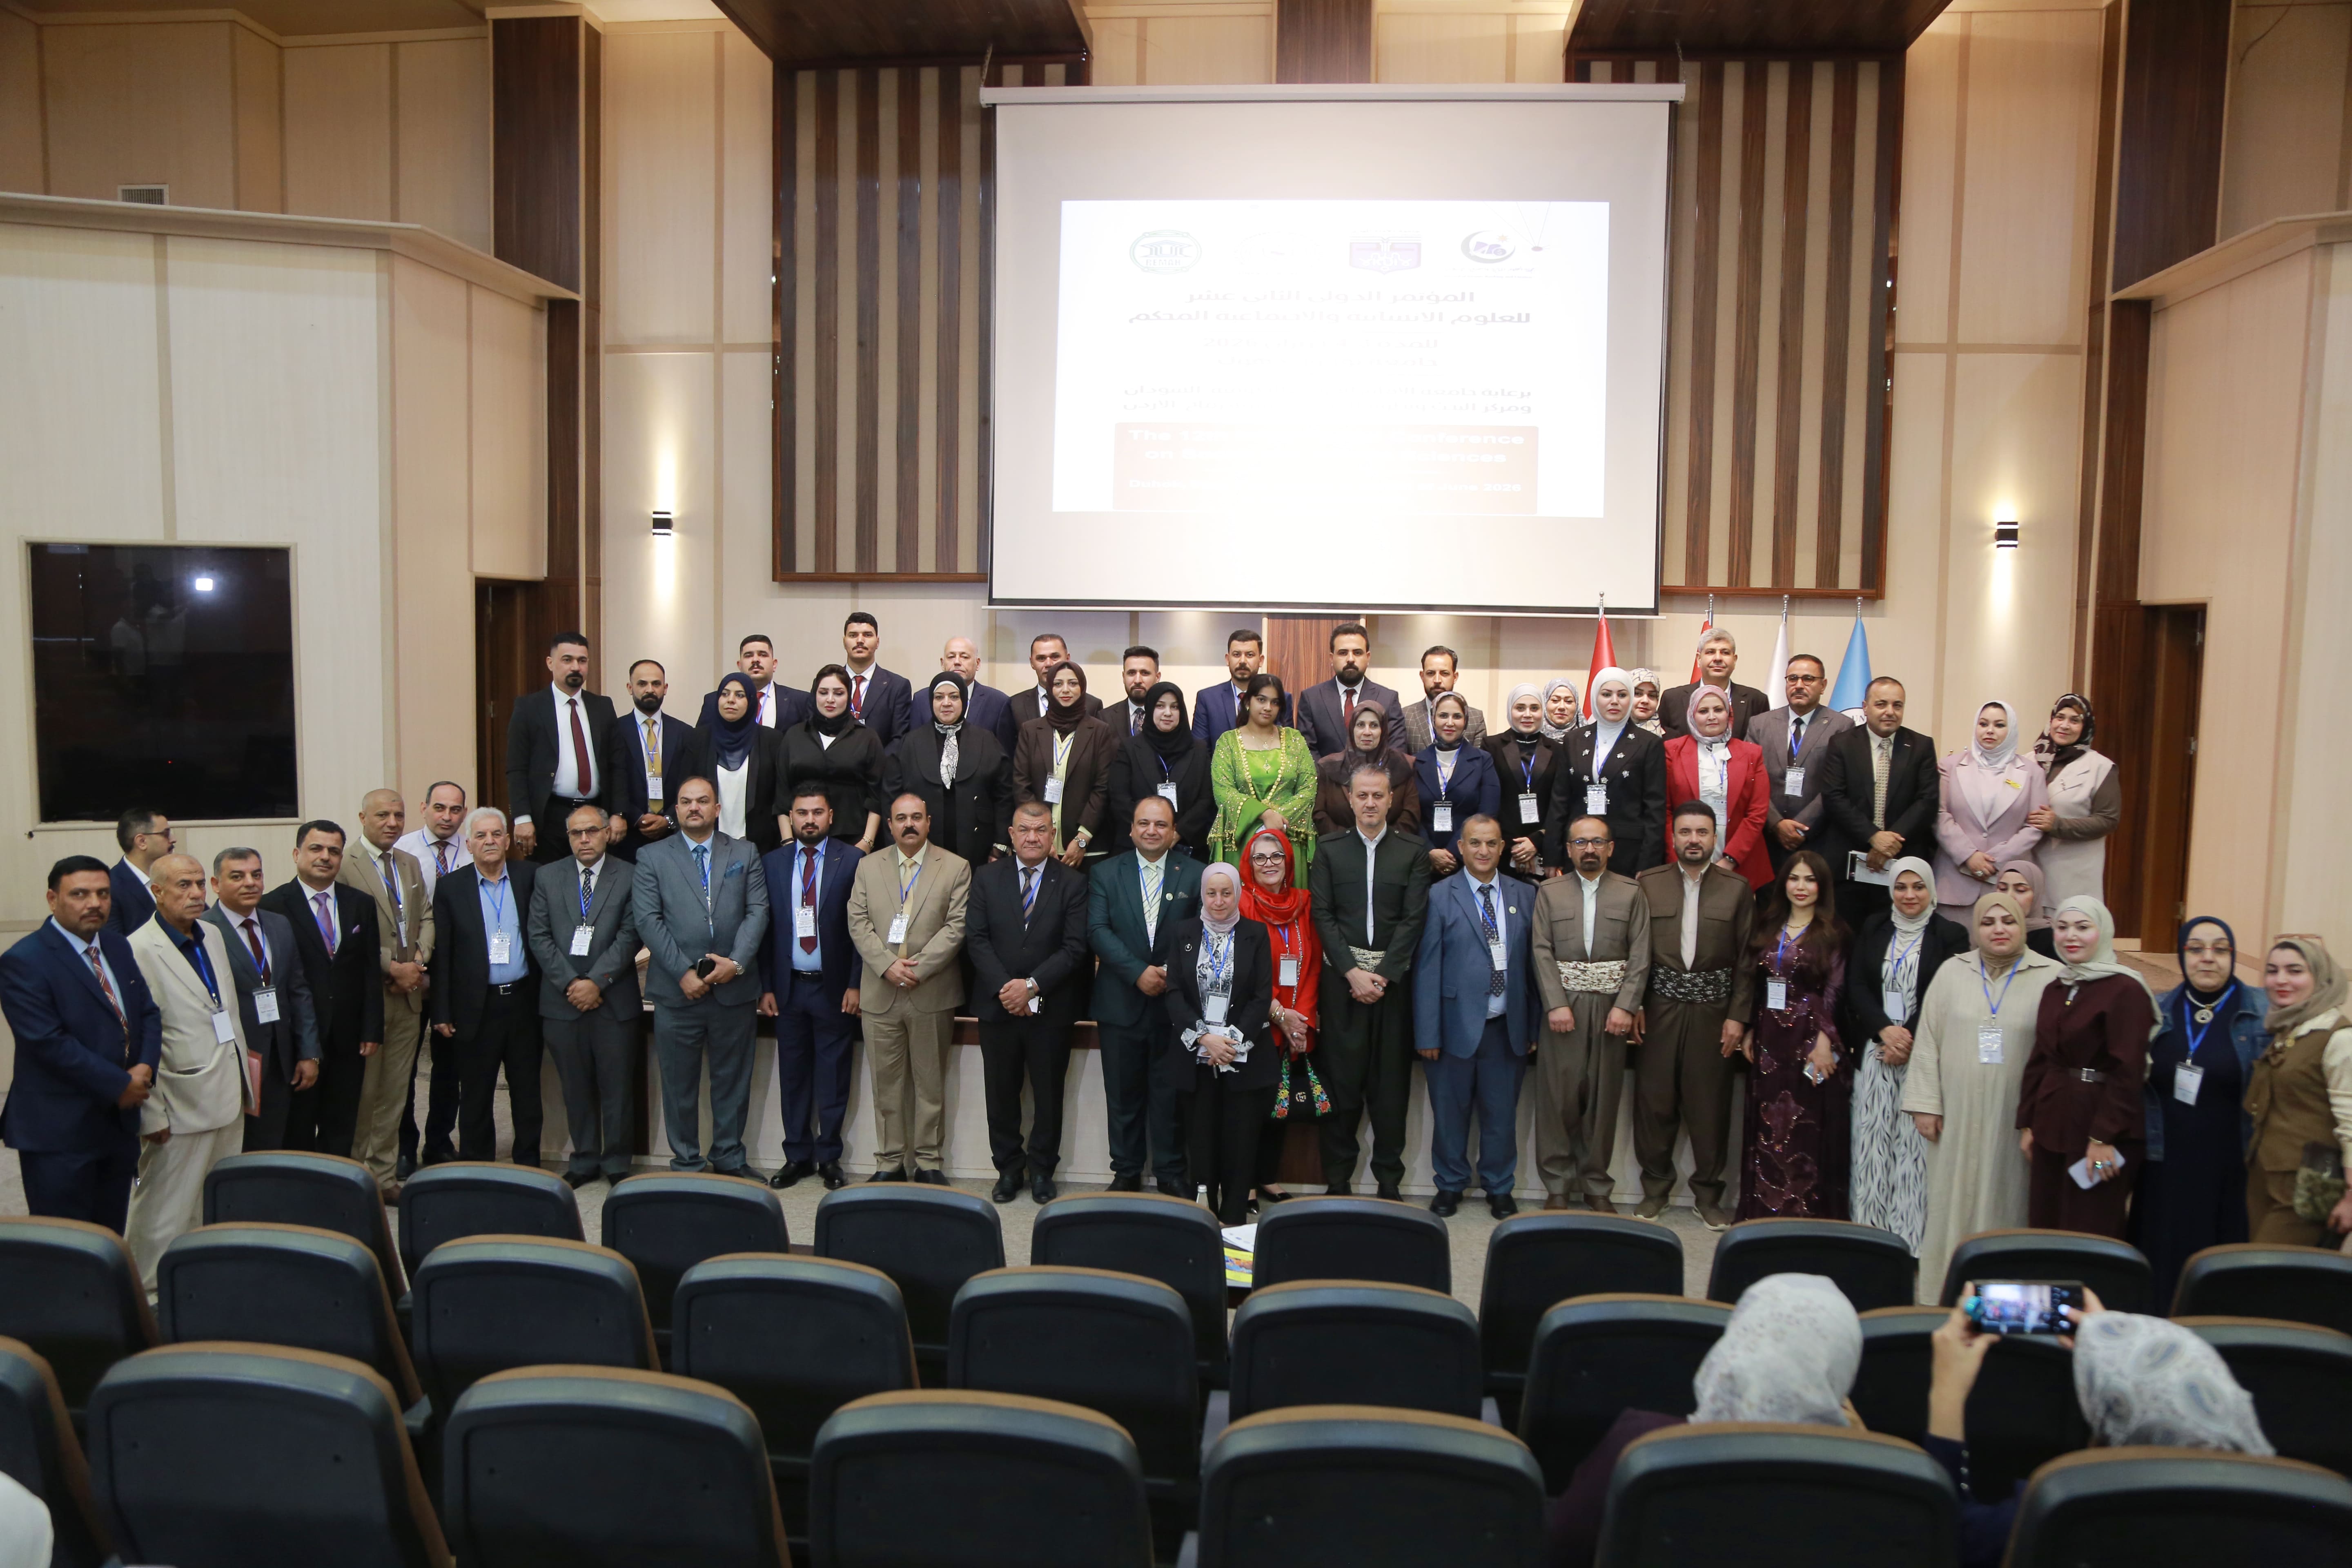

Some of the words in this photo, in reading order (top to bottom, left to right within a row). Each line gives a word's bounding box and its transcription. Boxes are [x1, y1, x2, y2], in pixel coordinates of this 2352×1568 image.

[1451, 312, 1530, 325] للعلوم
[1128, 429, 1171, 441] The
[1145, 450, 1173, 459] on
[1483, 483, 1522, 492] 2026
